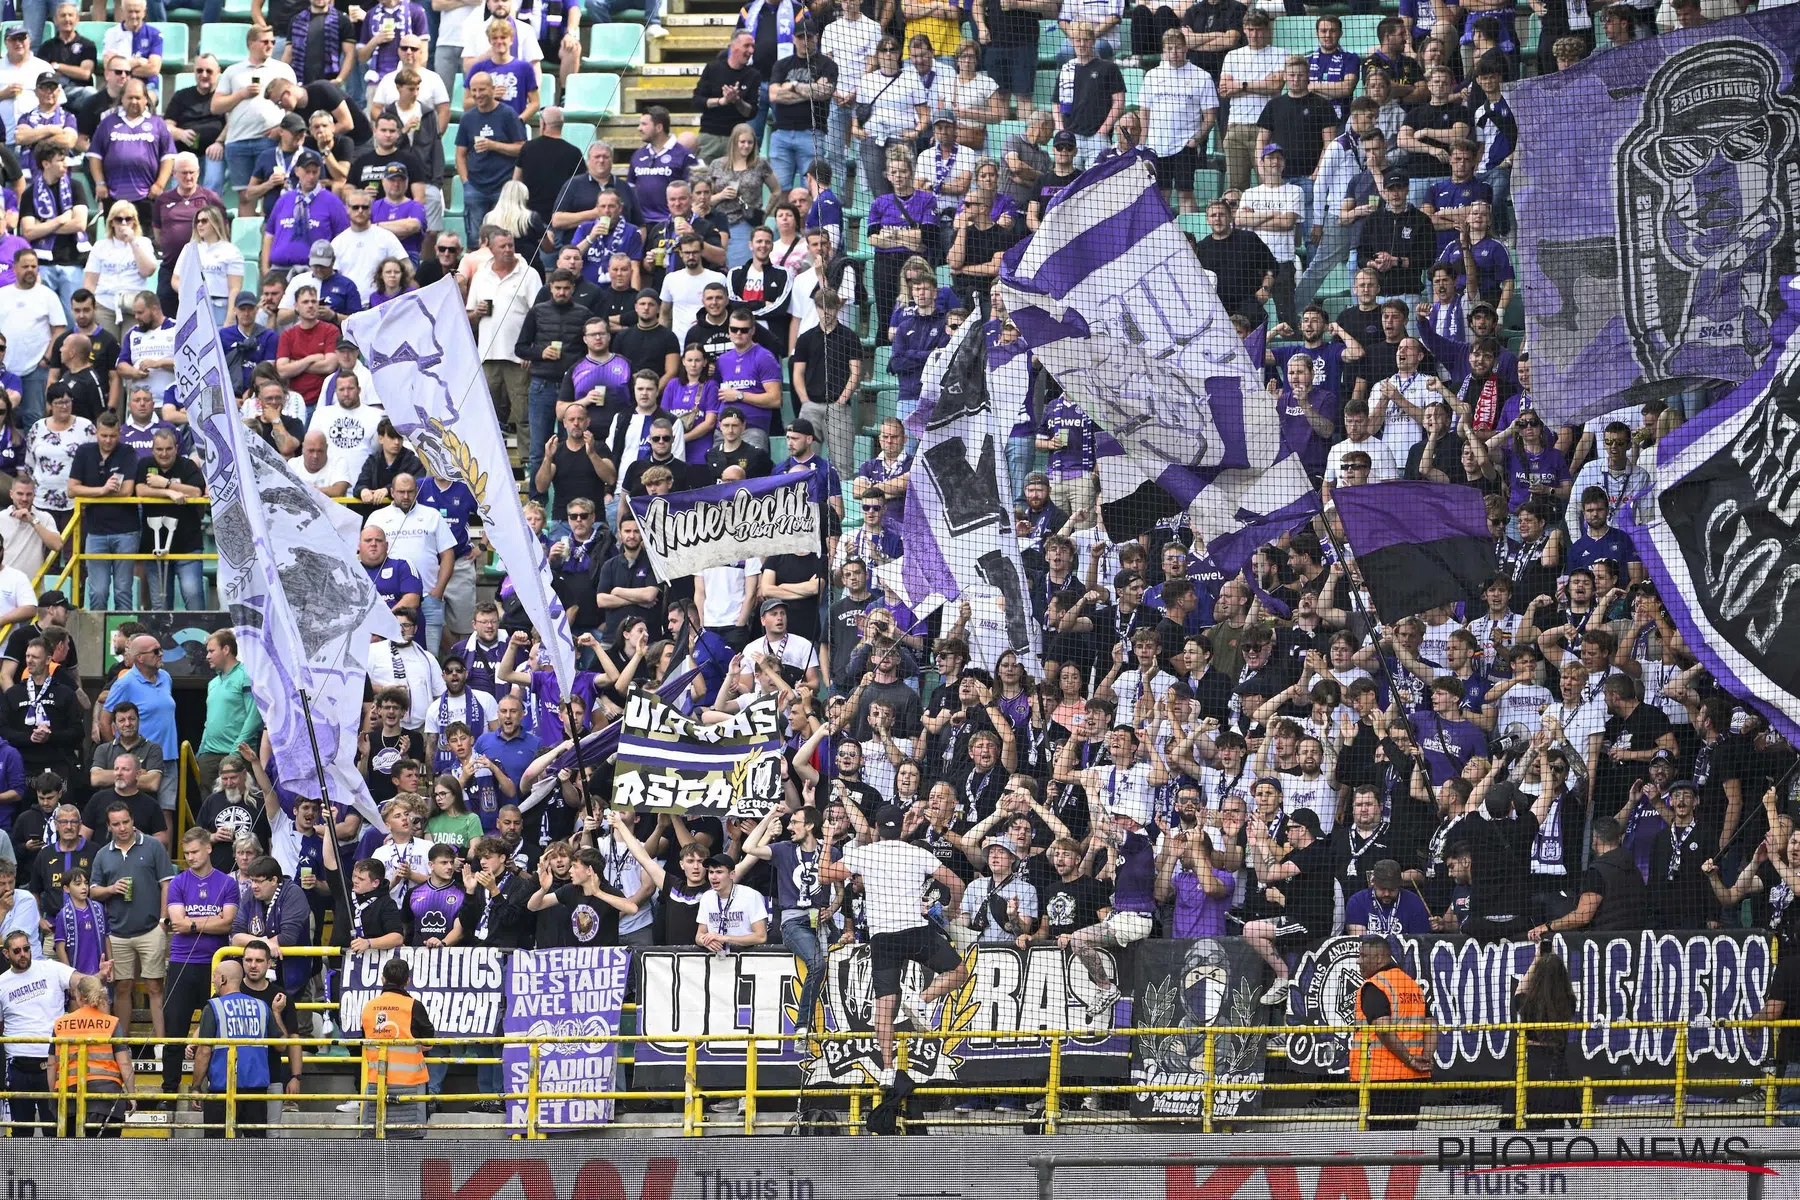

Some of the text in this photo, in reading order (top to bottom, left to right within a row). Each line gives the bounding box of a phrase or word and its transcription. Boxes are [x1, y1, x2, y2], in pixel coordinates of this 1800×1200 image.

[638, 480, 810, 557] Anderlecht
[624, 694, 779, 744] ULTRAS
[613, 770, 733, 809] RSCA
[456, 833, 464, 845] &
[400, 946, 502, 989] POLITICS
[511, 947, 628, 973] INTERDITS
[511, 966, 627, 995] DE STADE
[1307, 963, 1328, 1009] ULTRAS
[224, 998, 258, 1017] CHIEF
[512, 988, 623, 1018] AVEC NOUS
[641, 951, 800, 1055] ULT
[1581, 930, 1770, 1068] LEADERS
[57, 1018, 111, 1032] STEWARD
[696, 1170, 814, 1200] Thuis in
